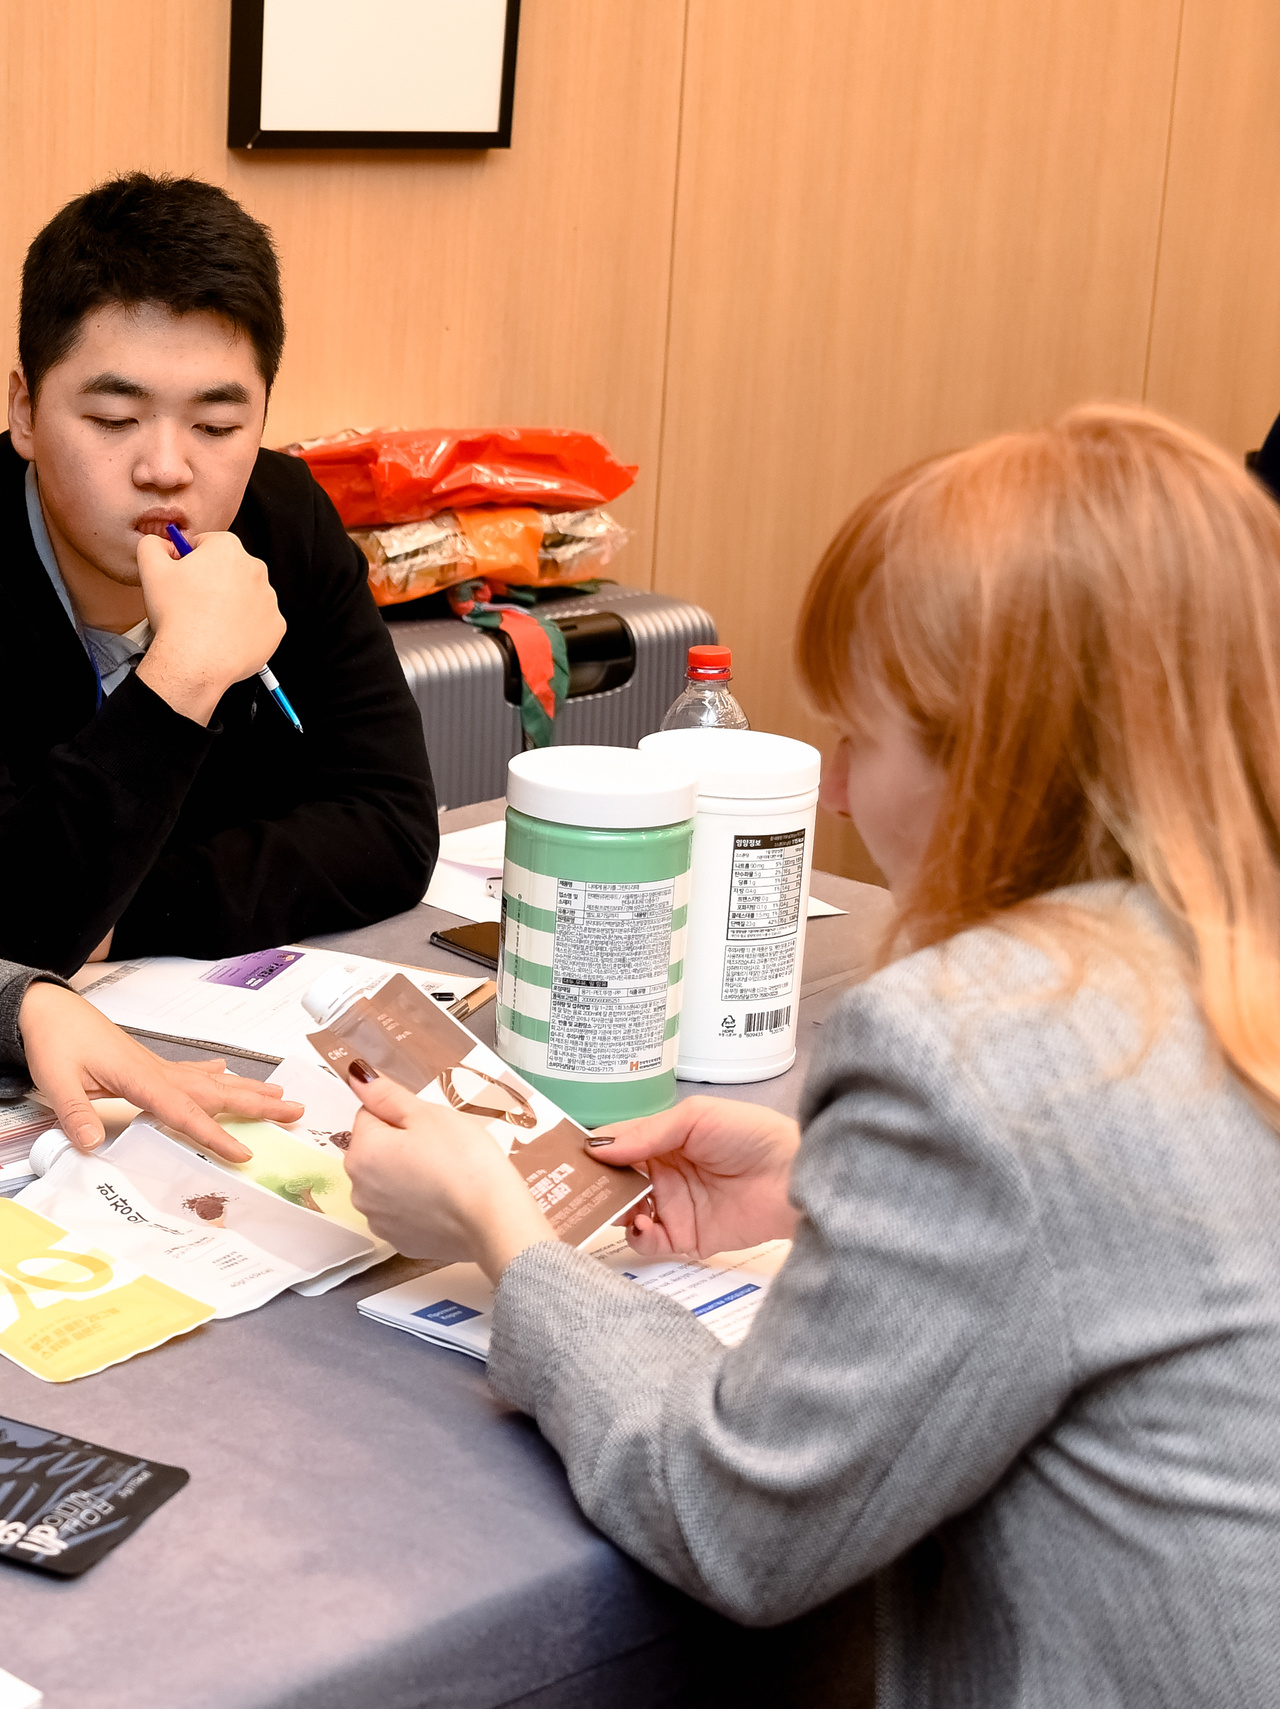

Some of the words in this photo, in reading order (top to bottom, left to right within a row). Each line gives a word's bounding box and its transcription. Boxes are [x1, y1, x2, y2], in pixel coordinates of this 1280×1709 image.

[736, 839, 762, 847] 영양정보
[327, 1046, 348, 1062] CHC
[16, 1523, 69, 1556] UP
